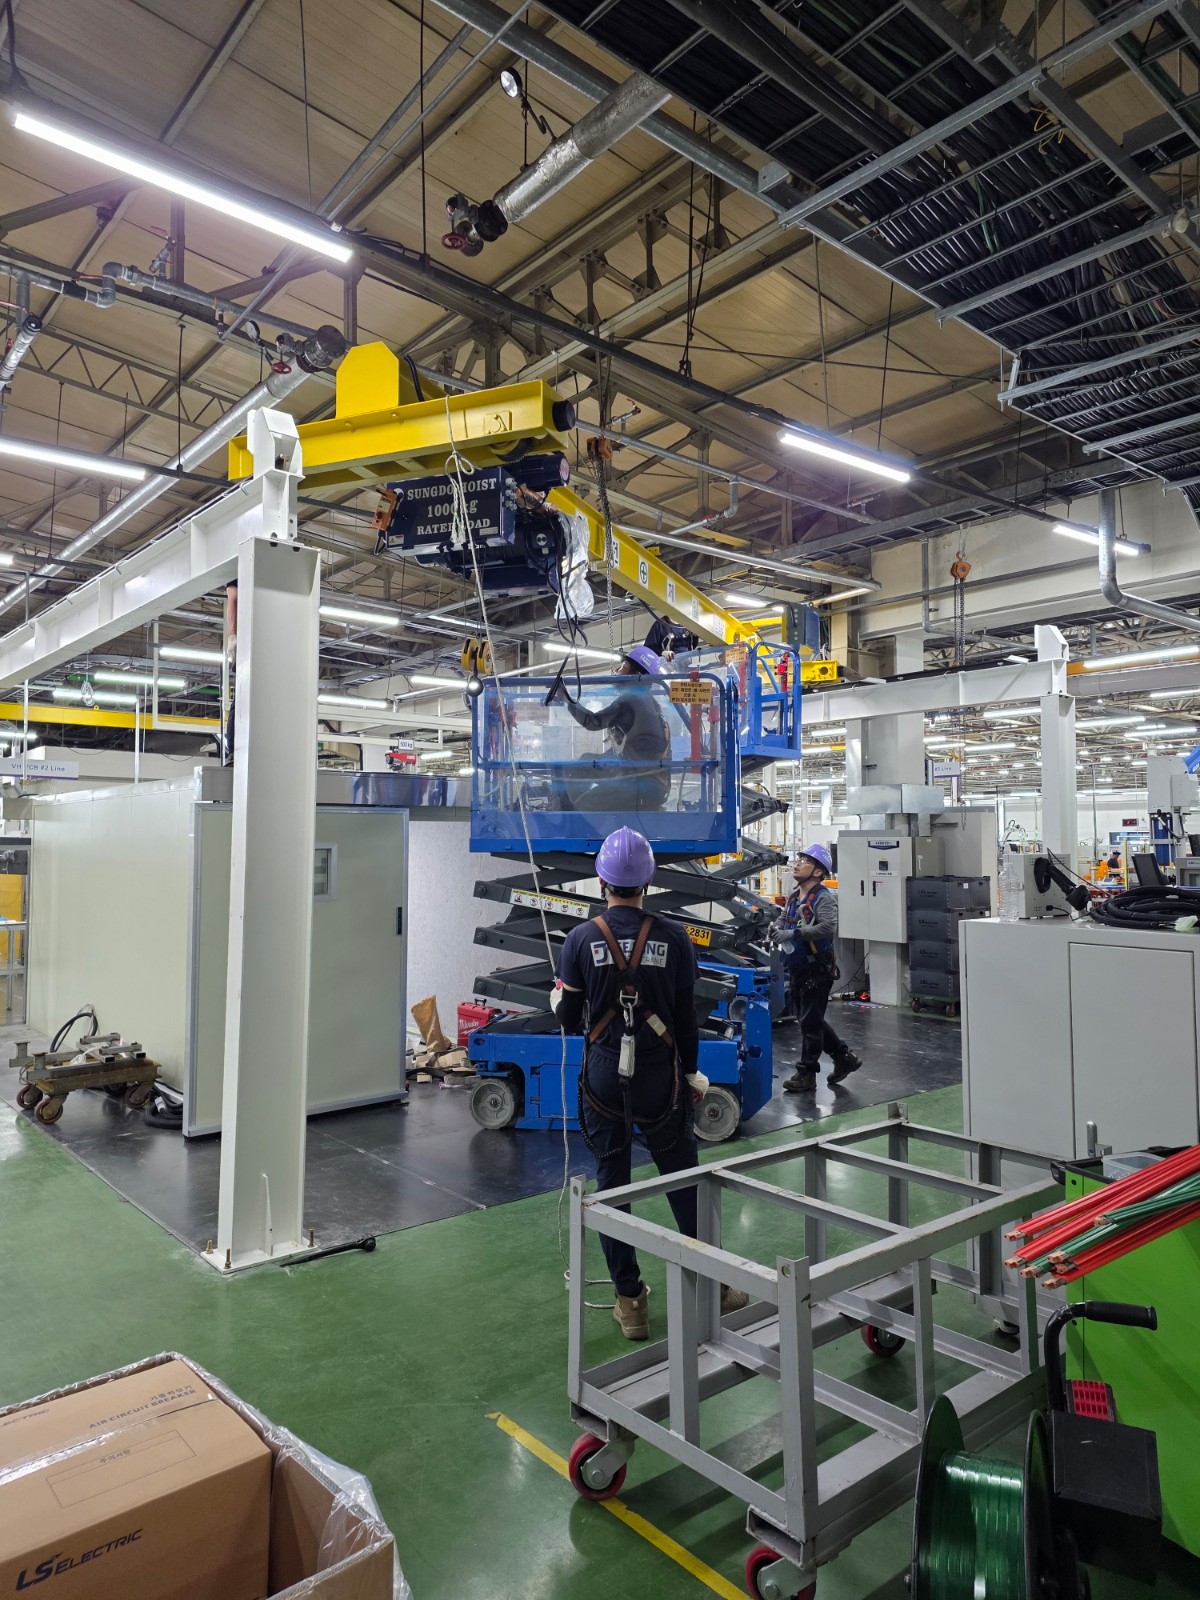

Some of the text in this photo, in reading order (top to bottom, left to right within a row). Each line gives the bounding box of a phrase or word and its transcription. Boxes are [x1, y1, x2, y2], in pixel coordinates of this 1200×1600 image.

[407, 478, 497, 500] SUNGDO HOIST
[427, 502, 457, 518] 1000
[89, 1389, 197, 1429] AIR CIRCUIT BREAKER
